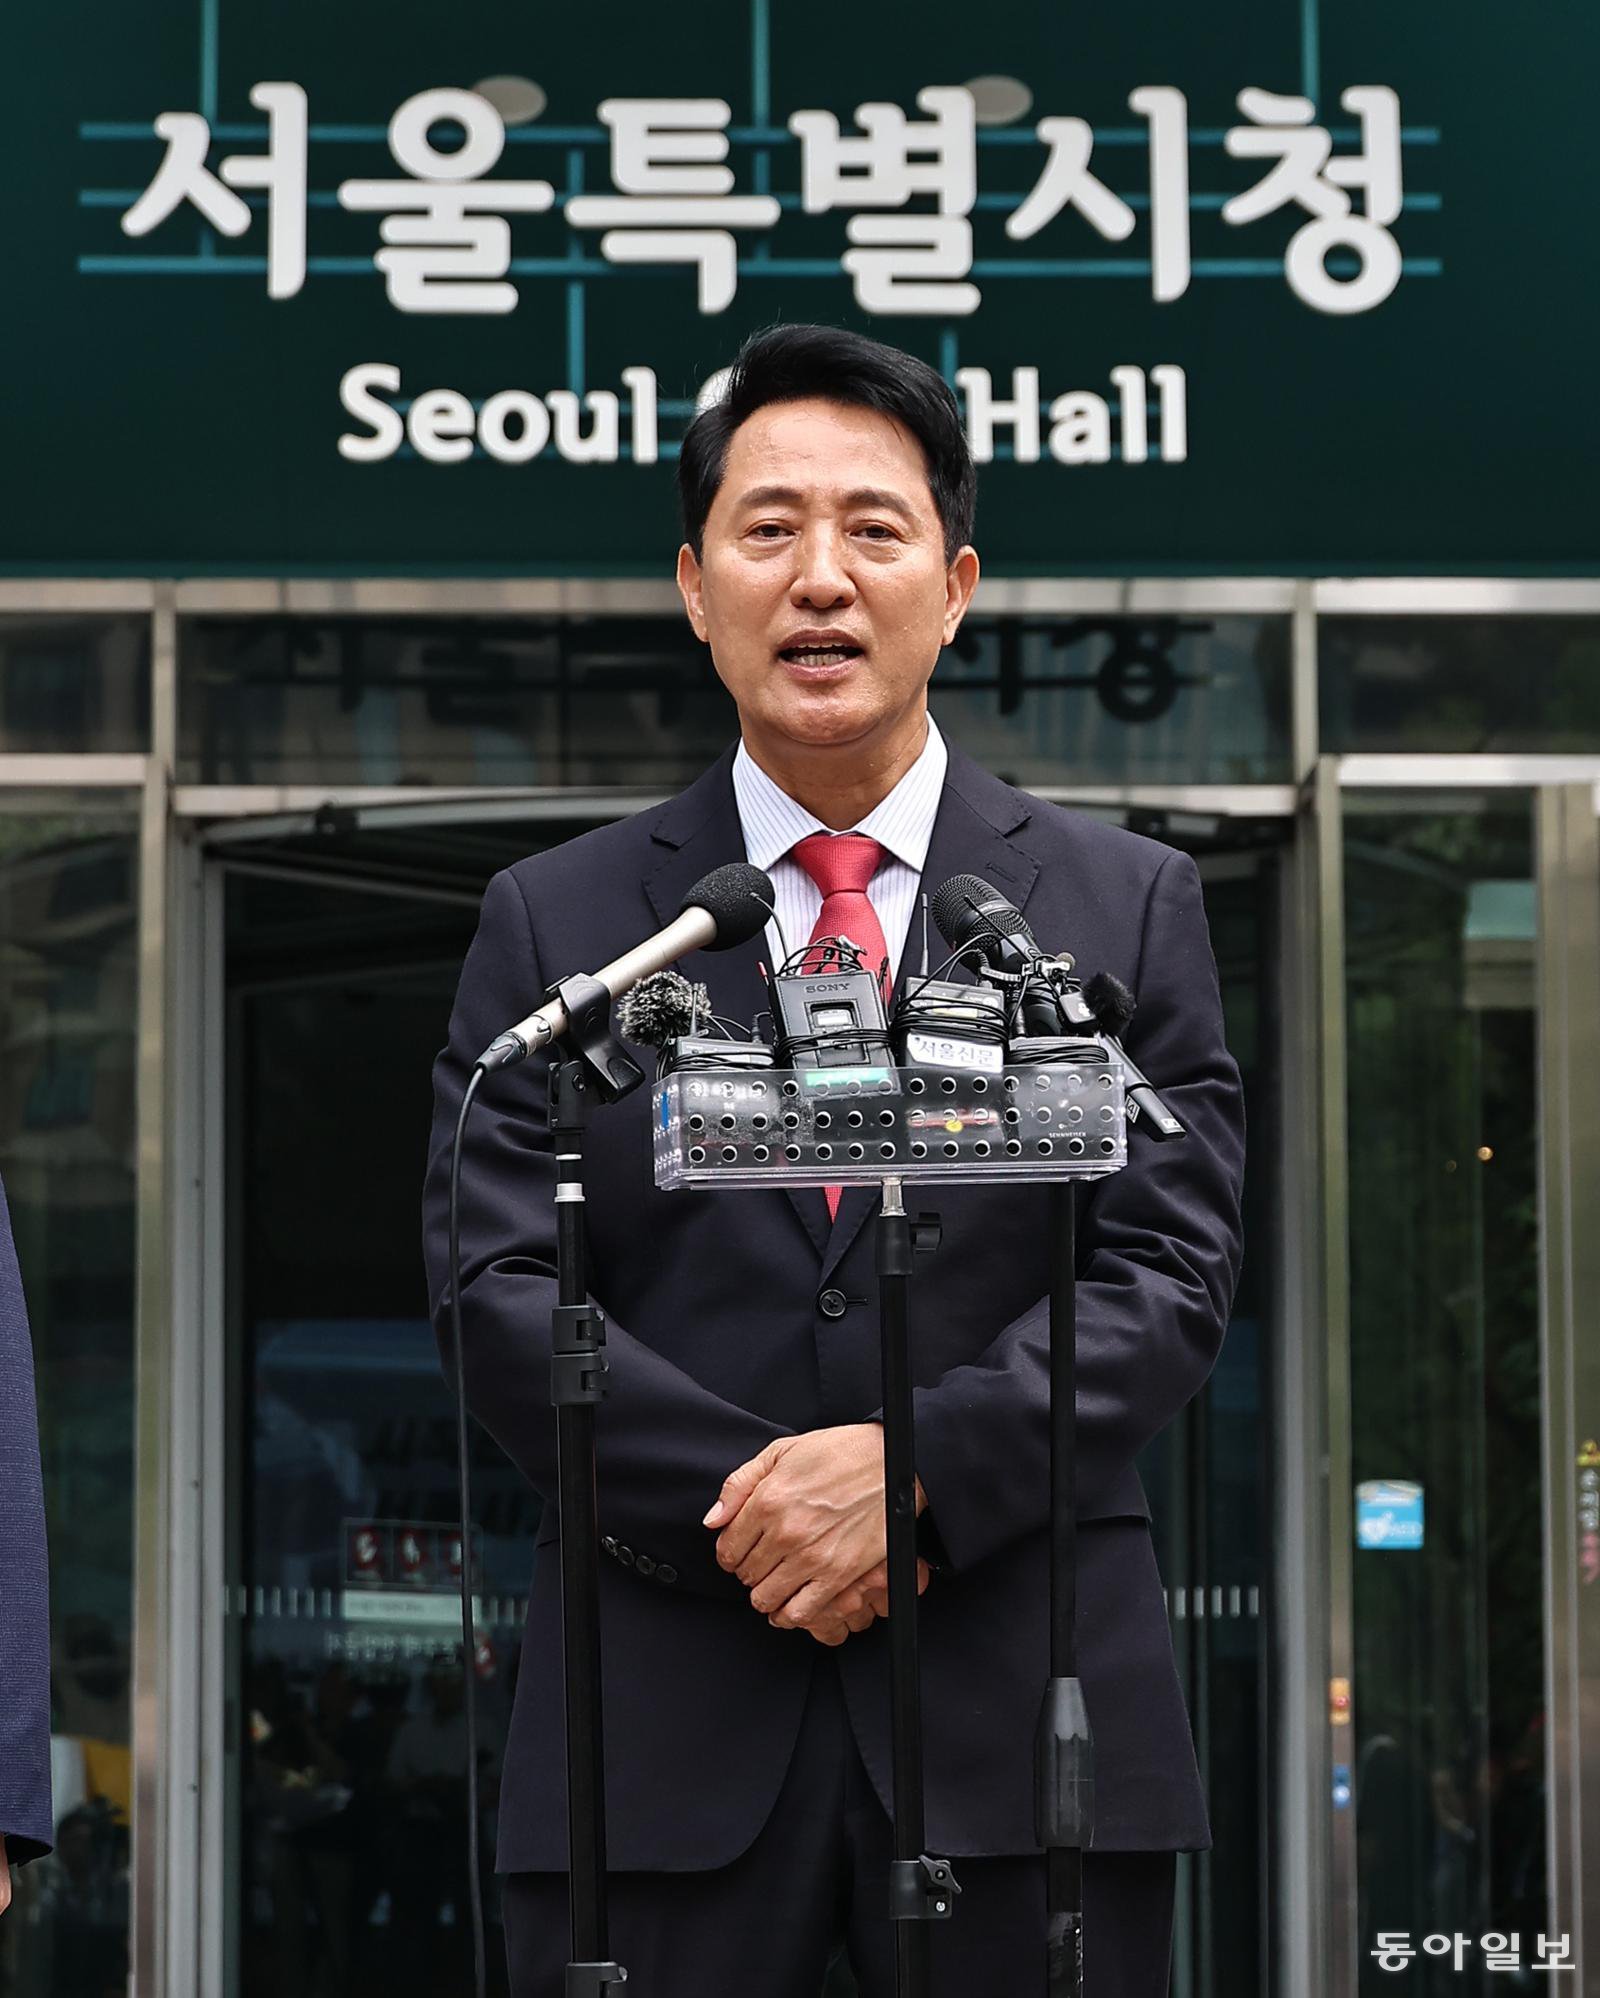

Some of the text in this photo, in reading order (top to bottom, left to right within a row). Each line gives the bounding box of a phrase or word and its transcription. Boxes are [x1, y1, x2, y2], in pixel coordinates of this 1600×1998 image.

[121, 82, 1403, 315] 서울특별시청
[338, 363, 659, 464] Seoul
[955, 364, 1188, 465] Hall
[805, 982, 850, 994] SONY
